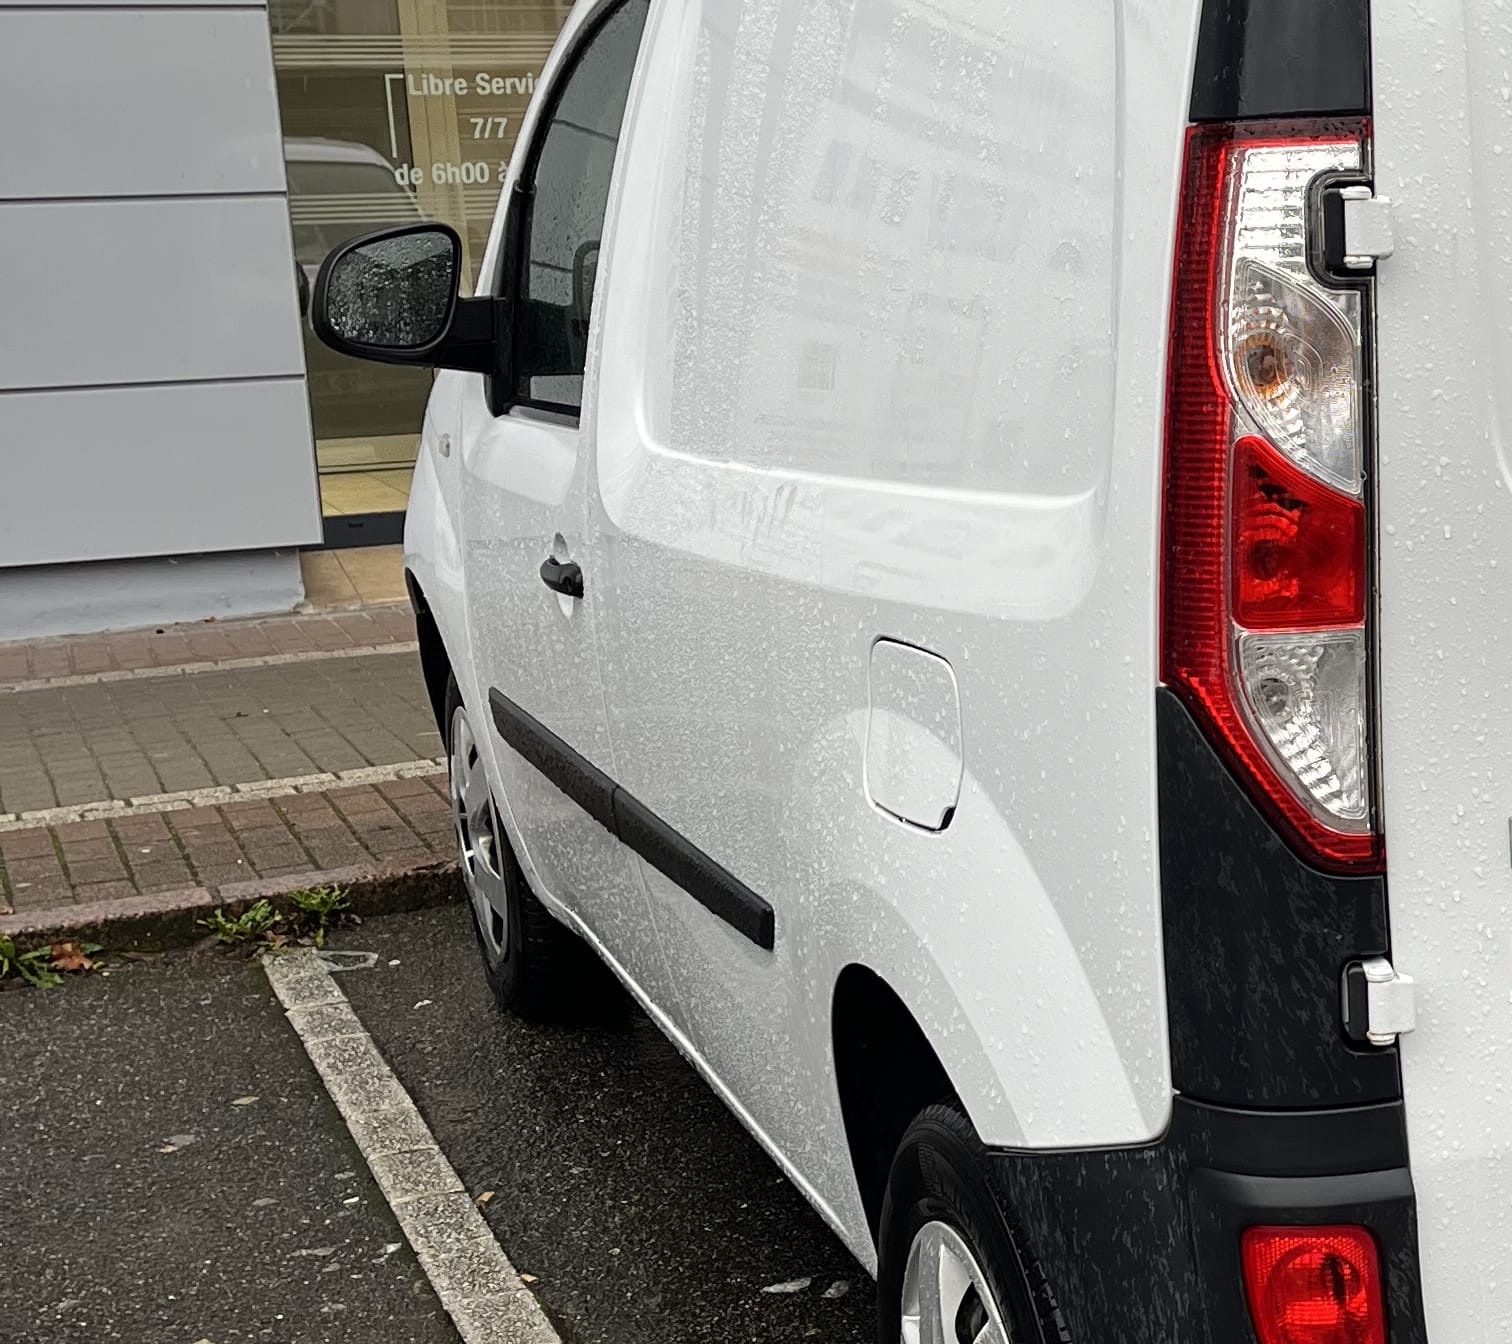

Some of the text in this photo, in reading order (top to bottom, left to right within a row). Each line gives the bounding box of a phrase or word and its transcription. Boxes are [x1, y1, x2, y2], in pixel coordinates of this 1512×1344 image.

[407, 73, 468, 96] Libre
[469, 117, 508, 139] 7/7
[394, 163, 424, 186] de
[432, 162, 490, 185] 6h00
